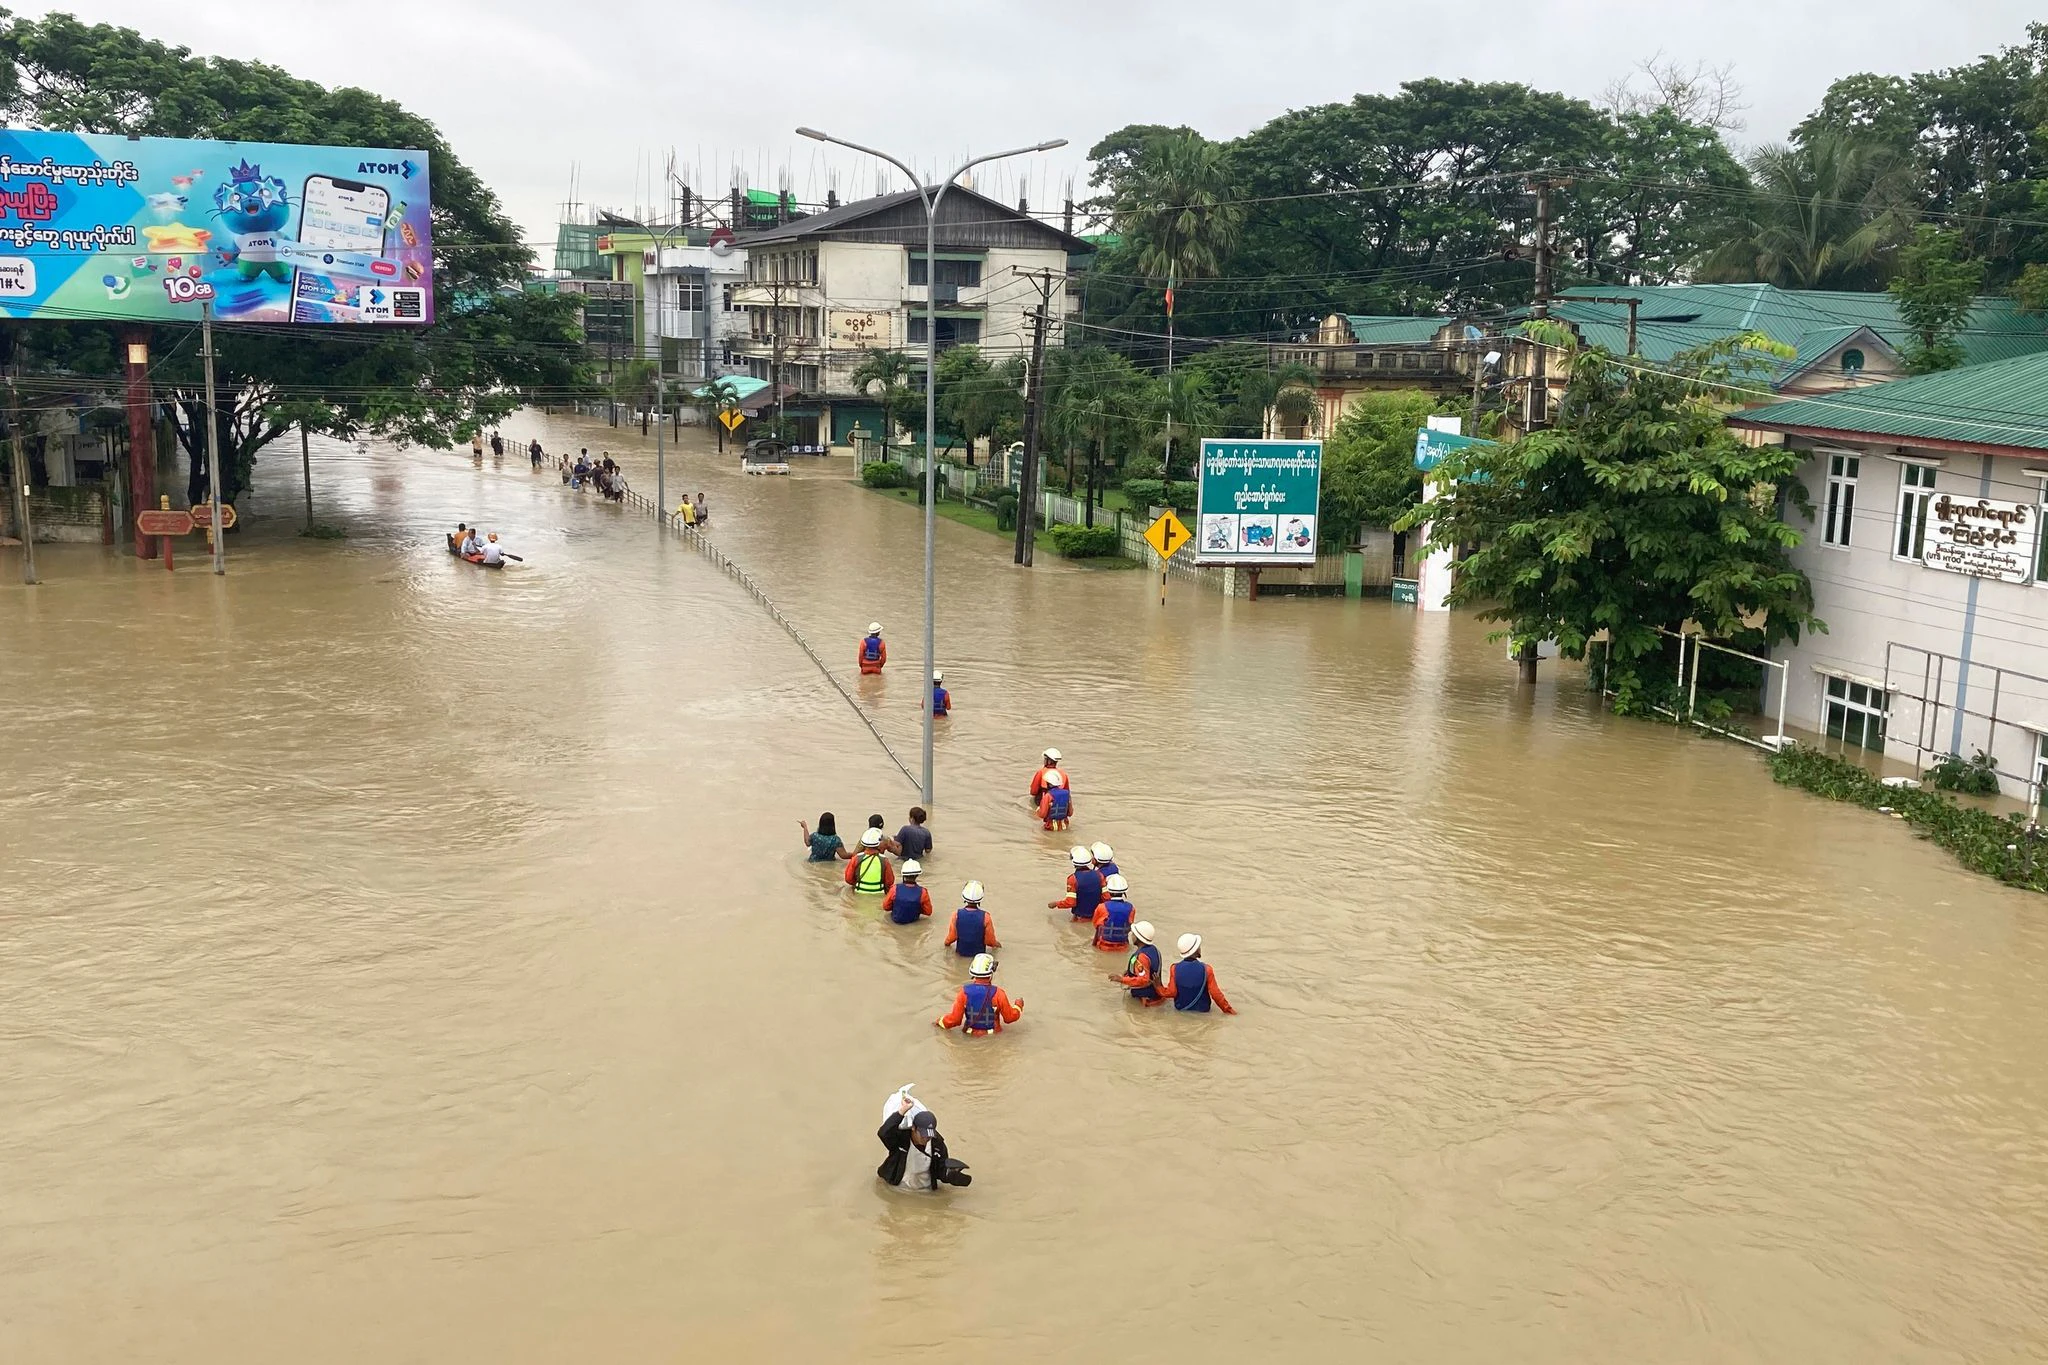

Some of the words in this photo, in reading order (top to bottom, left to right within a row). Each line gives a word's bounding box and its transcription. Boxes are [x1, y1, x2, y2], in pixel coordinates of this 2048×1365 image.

[0, 156, 138, 187] န်ဆောင်မှုတွေသုံးတိုင်း
[357, 162, 398, 174] ATOM
[248, 239, 269, 247] ATOM
[1942, 554, 1961, 564] HTOO
